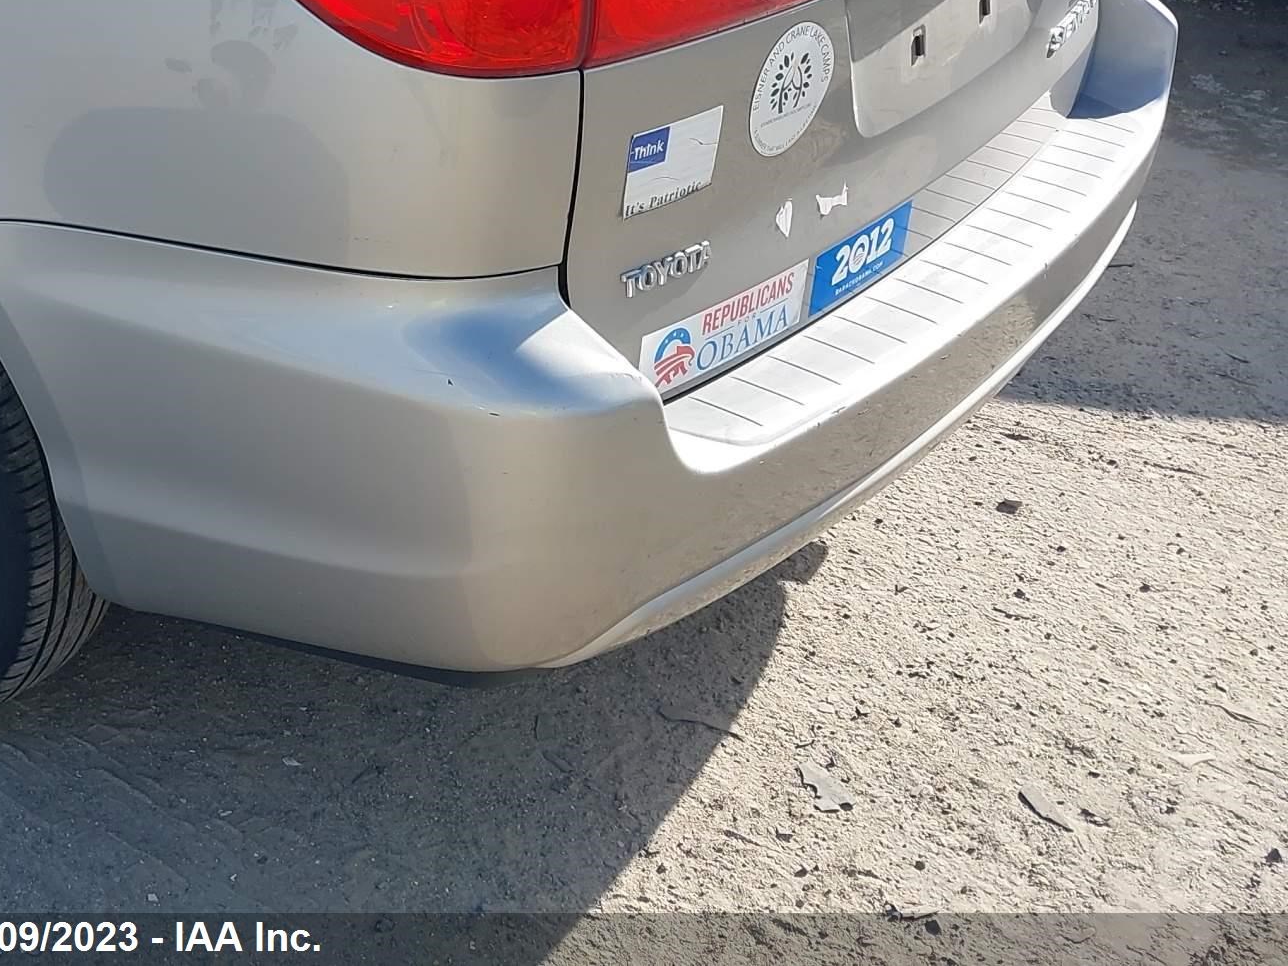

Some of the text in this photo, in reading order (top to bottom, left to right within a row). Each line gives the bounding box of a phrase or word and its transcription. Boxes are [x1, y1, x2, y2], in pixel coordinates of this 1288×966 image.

[753, 67, 770, 111] EISNER
[769, 41, 785, 65] AND
[634, 139, 665, 161] Think
[625, 202, 645, 217] It's
[621, 240, 712, 299] TOYOTA
[831, 217, 894, 285] 2012
[702, 272, 795, 335] REPUBLICANS
[696, 304, 789, 371] OBAMA
